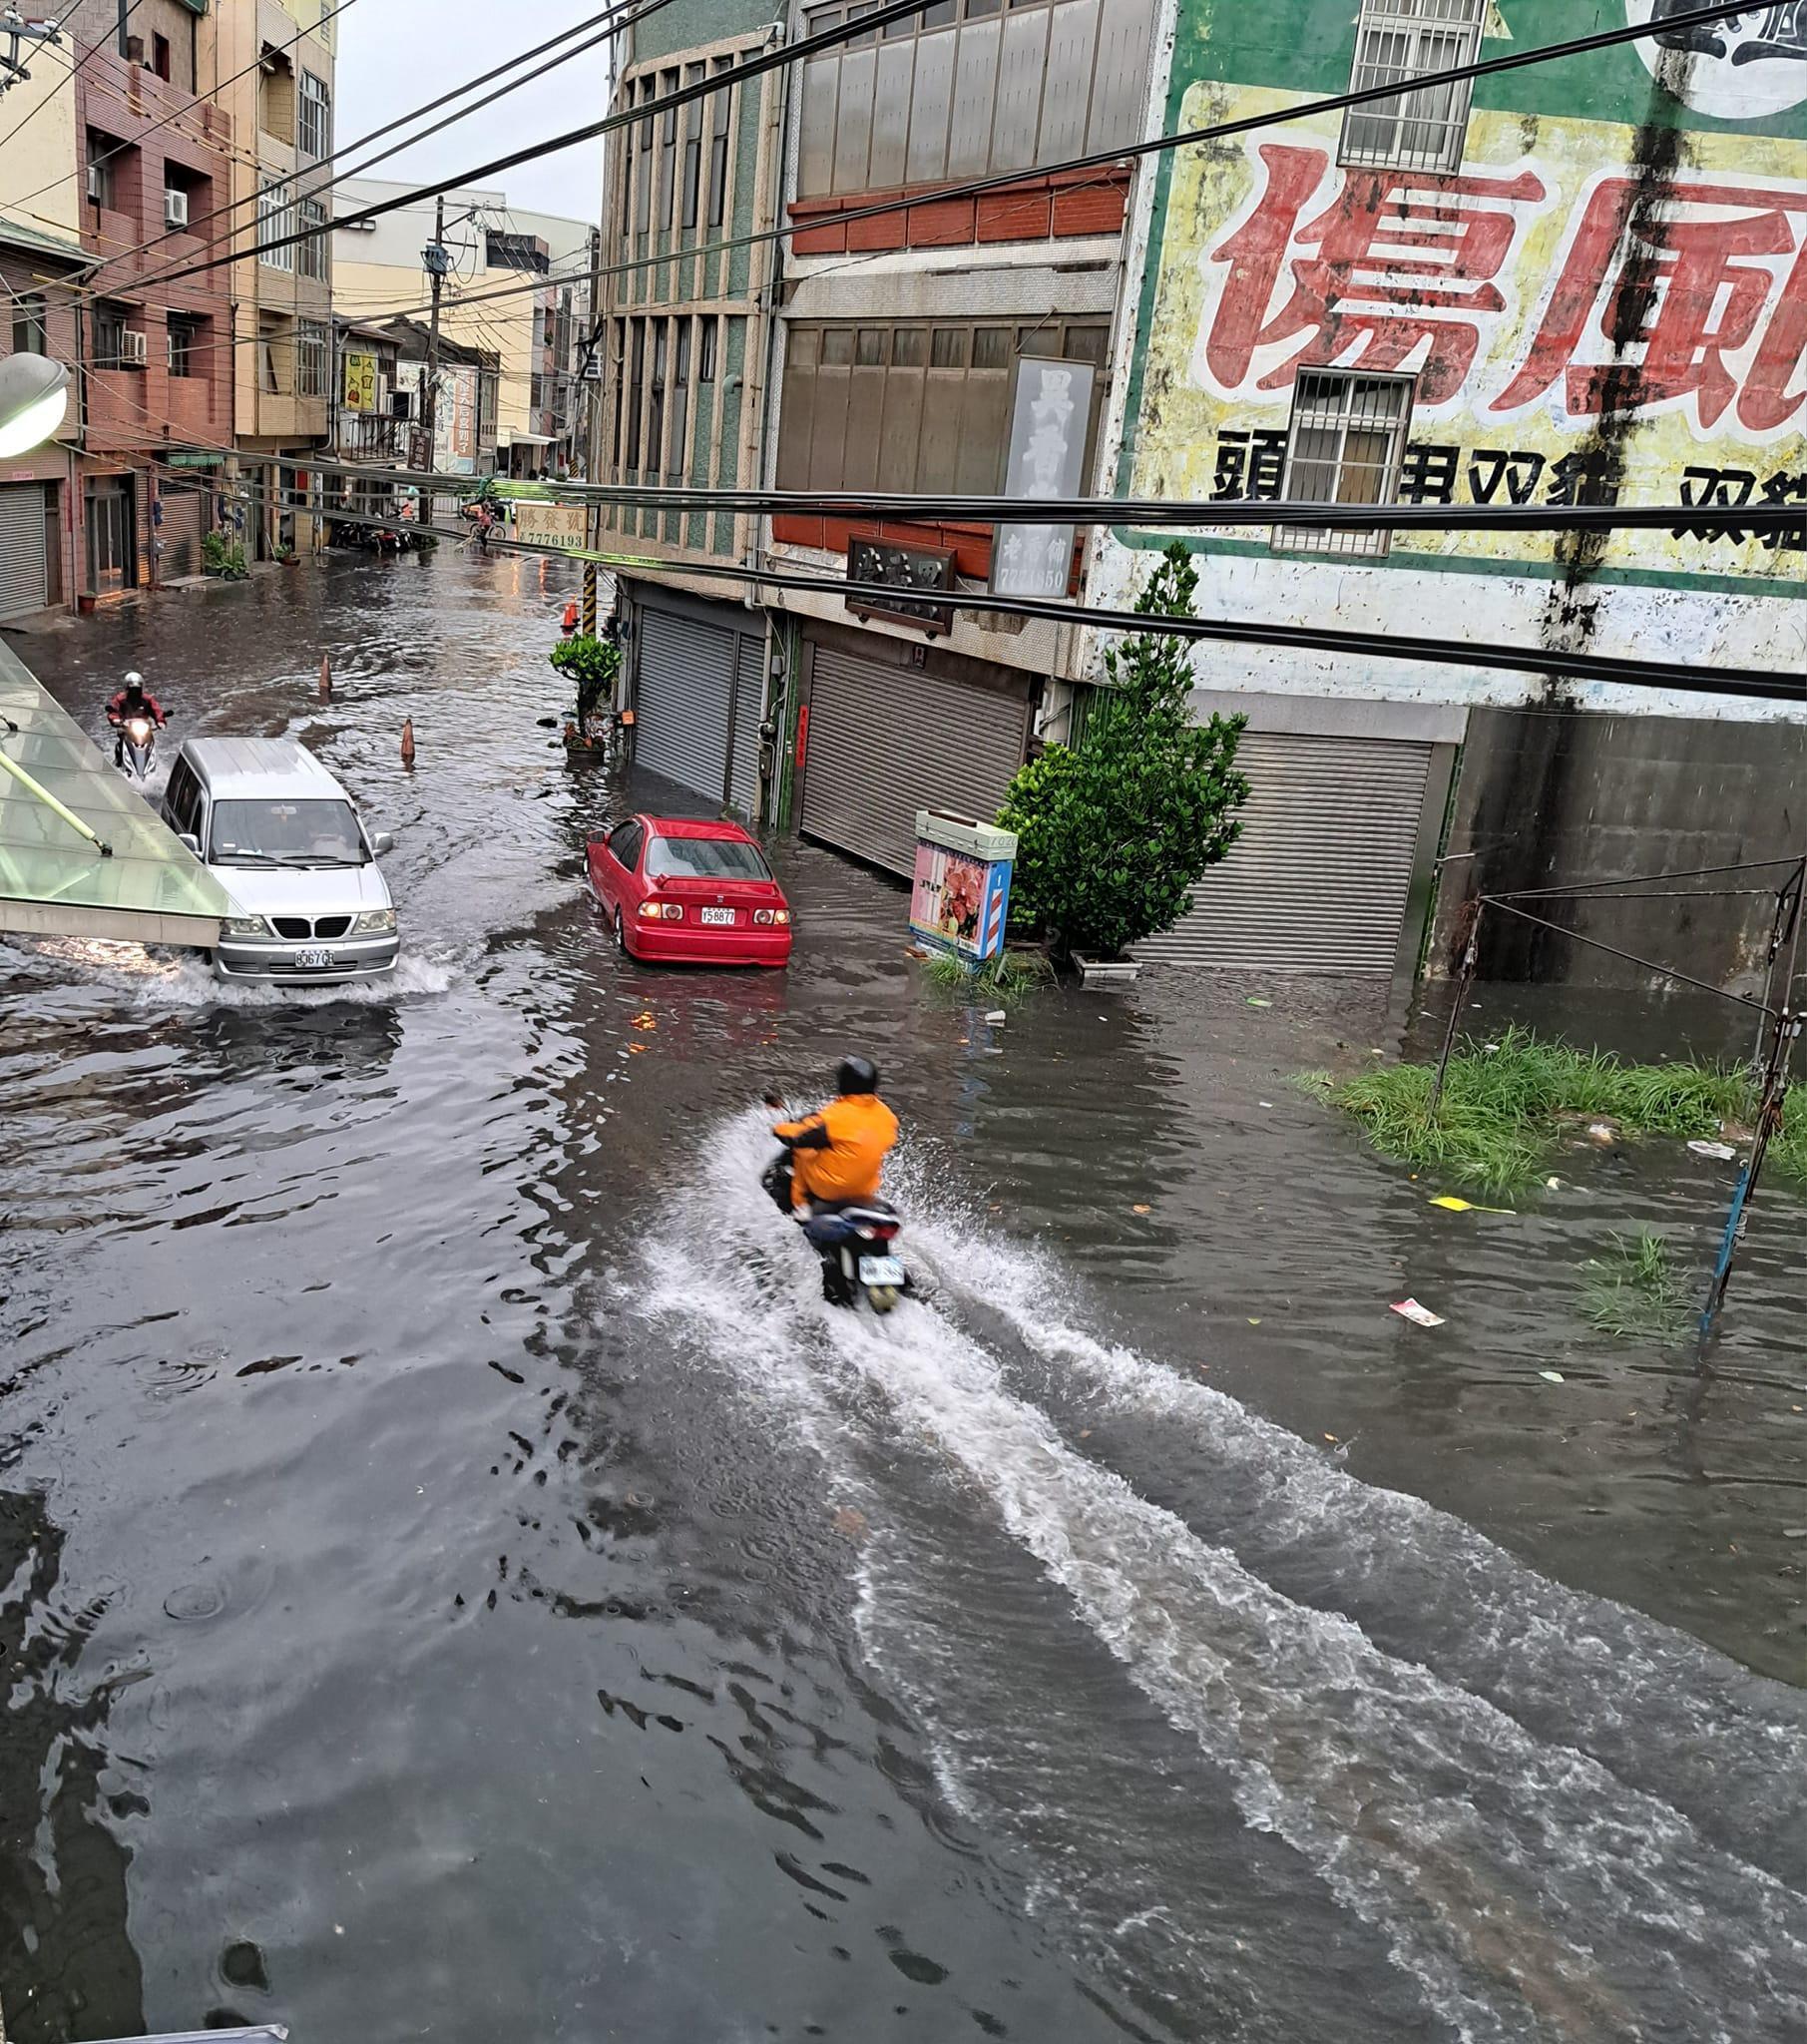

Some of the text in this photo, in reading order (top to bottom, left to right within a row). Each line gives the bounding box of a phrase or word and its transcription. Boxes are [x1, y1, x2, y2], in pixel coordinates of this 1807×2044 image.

[1206, 143, 1807, 430] 傷風
[519, 508, 584, 532] 勝發號
[529, 532, 583, 548] 7776193
